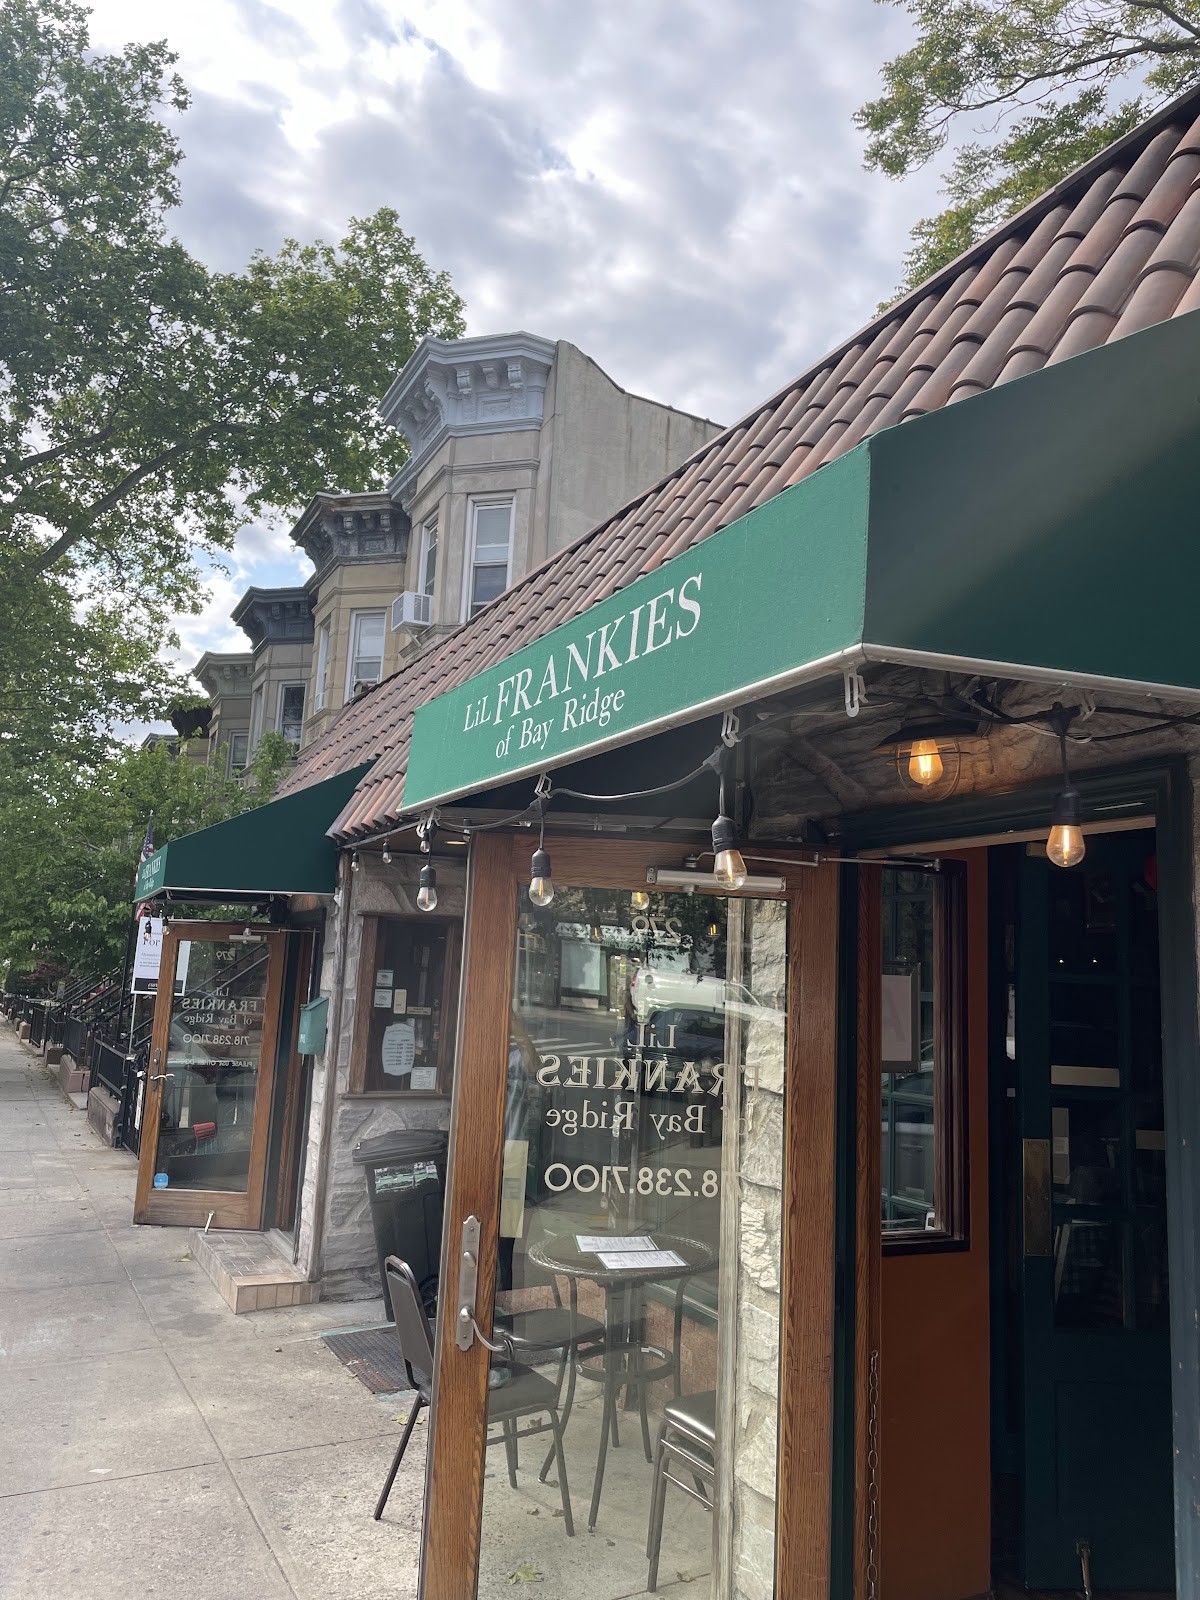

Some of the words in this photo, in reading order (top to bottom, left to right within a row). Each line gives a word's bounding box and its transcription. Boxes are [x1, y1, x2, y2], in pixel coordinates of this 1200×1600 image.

[493, 572, 702, 726] FRANKIES
[495, 724, 514, 759] of
[519, 717, 554, 750] Bay
[561, 686, 625, 727] Ridge
